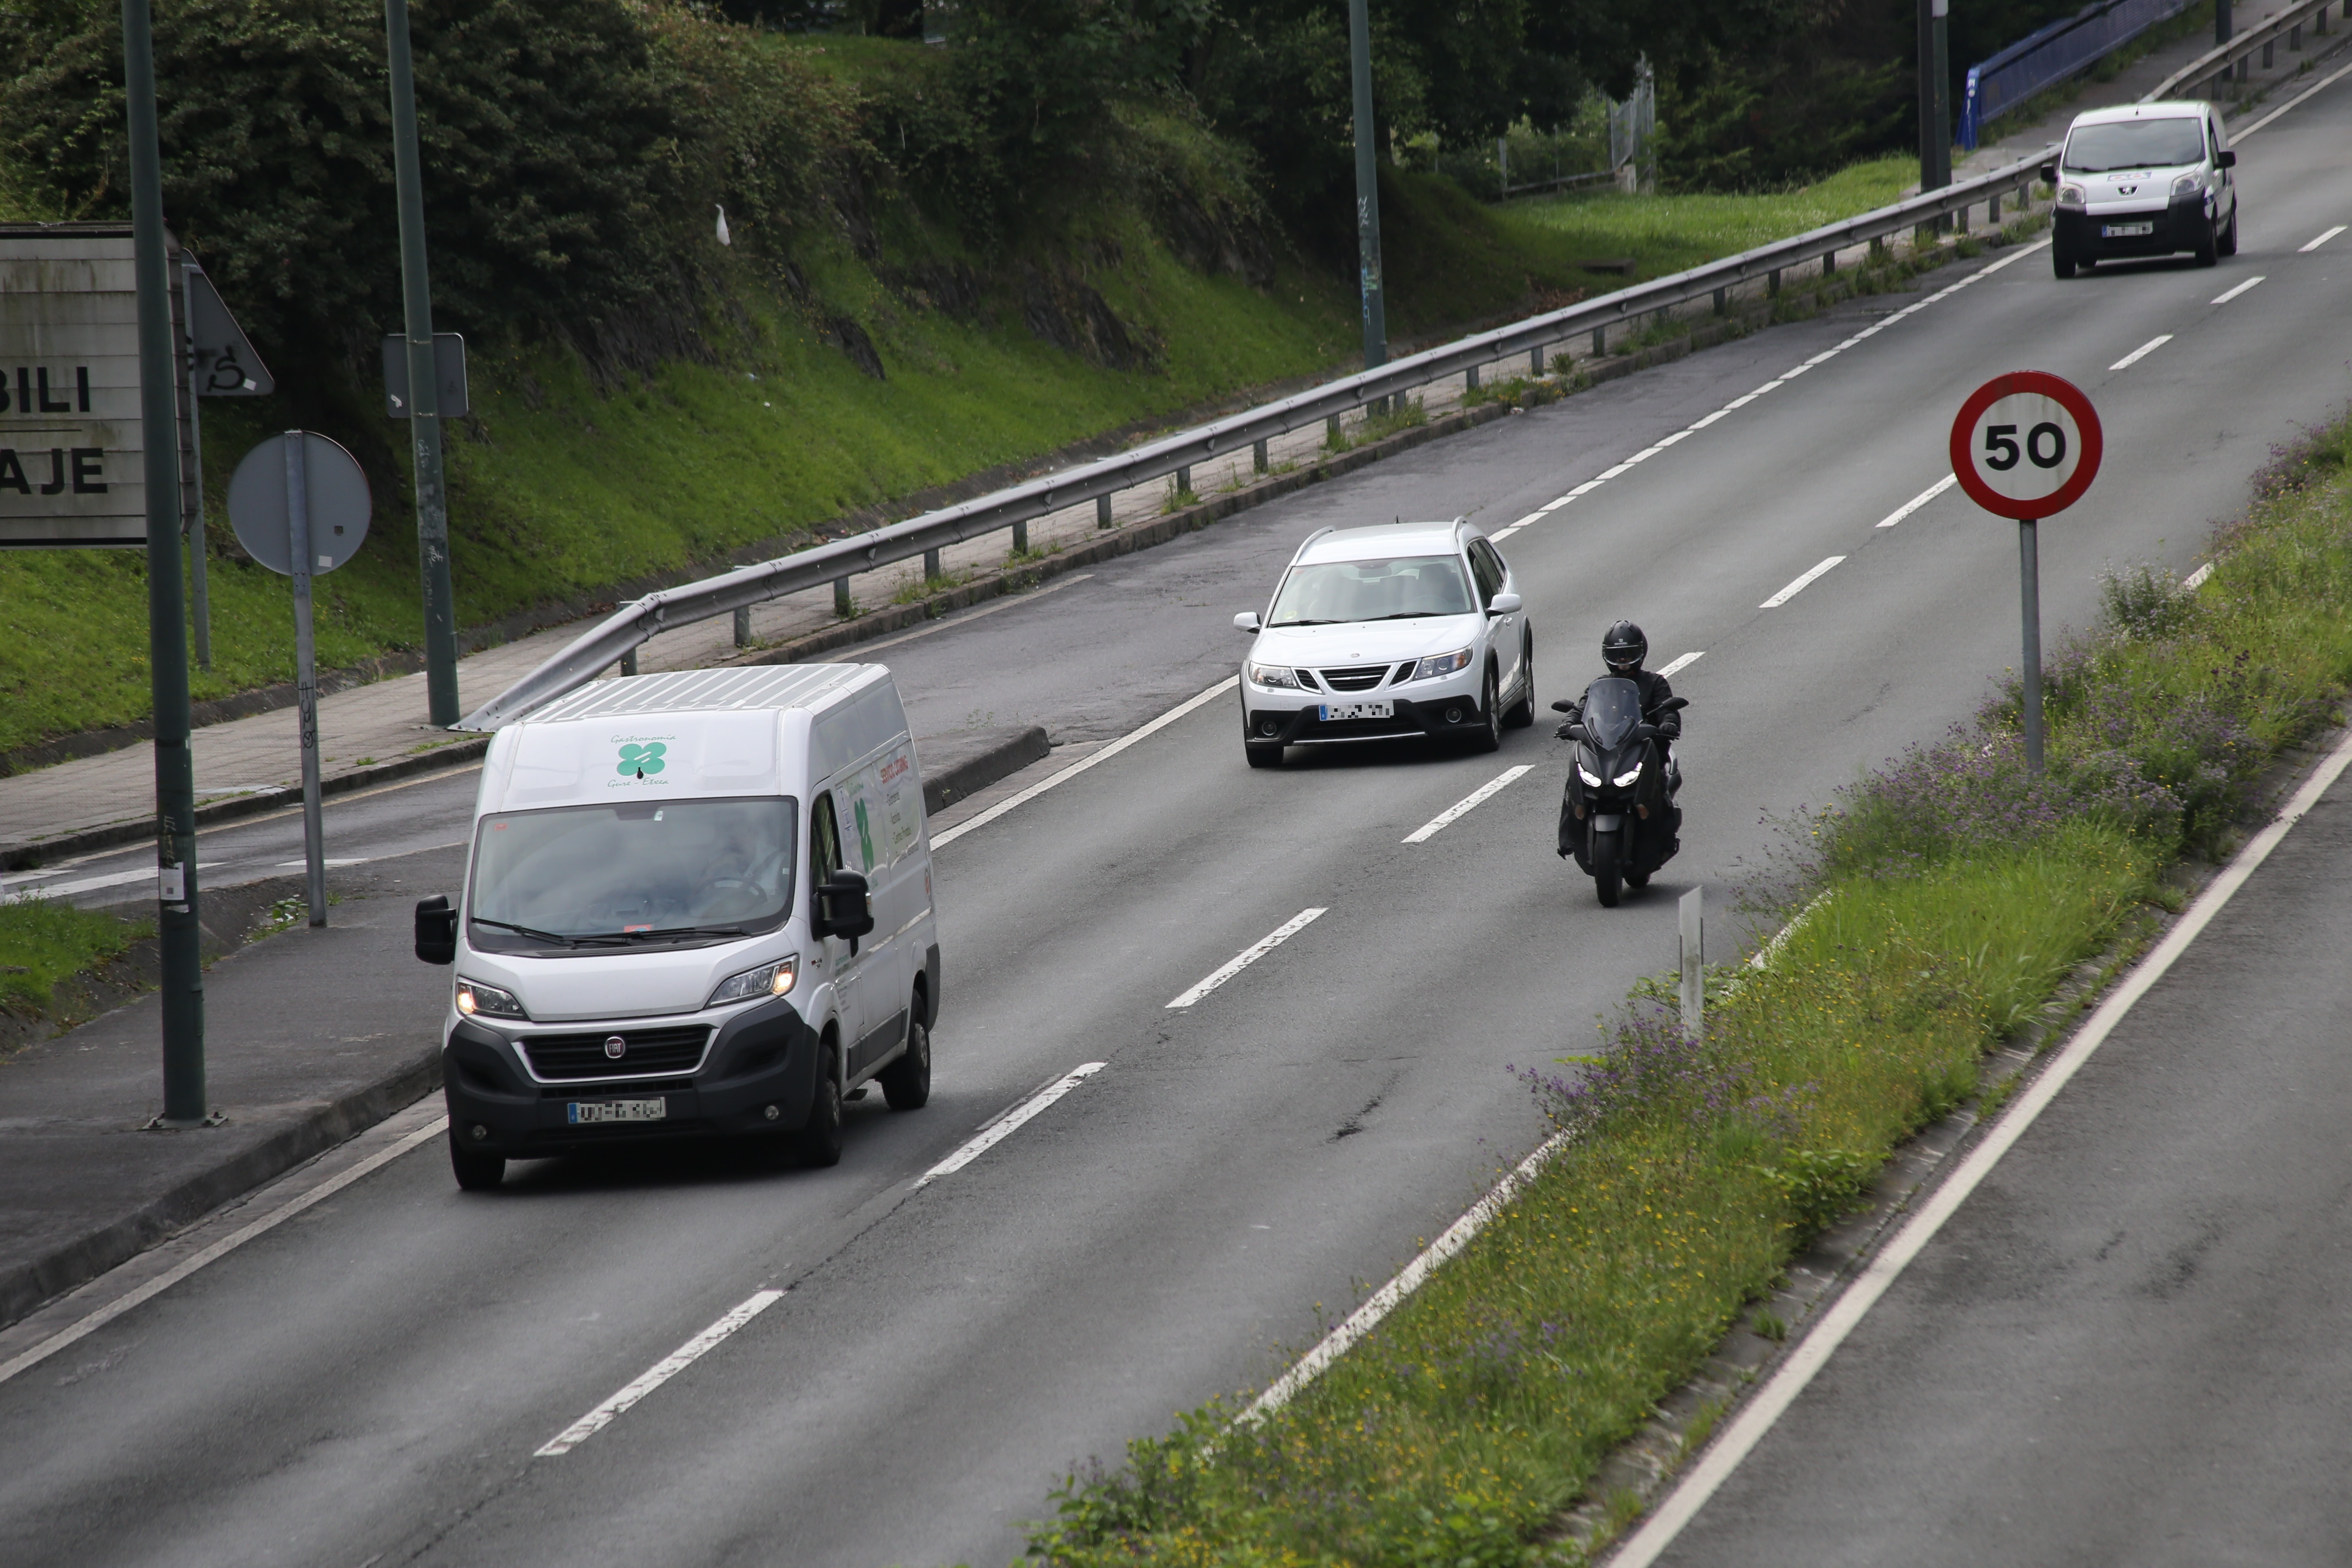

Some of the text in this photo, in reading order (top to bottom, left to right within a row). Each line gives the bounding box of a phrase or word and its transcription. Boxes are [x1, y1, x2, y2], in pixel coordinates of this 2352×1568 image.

[0, 366, 90, 413] ILI
[1985, 422, 2066, 471] 50
[610, 734, 677, 744] Gastronomía
[607, 779, 631, 788] Gure
[642, 777, 669, 786] Etxea
[609, 1043, 622, 1054] FIAT
